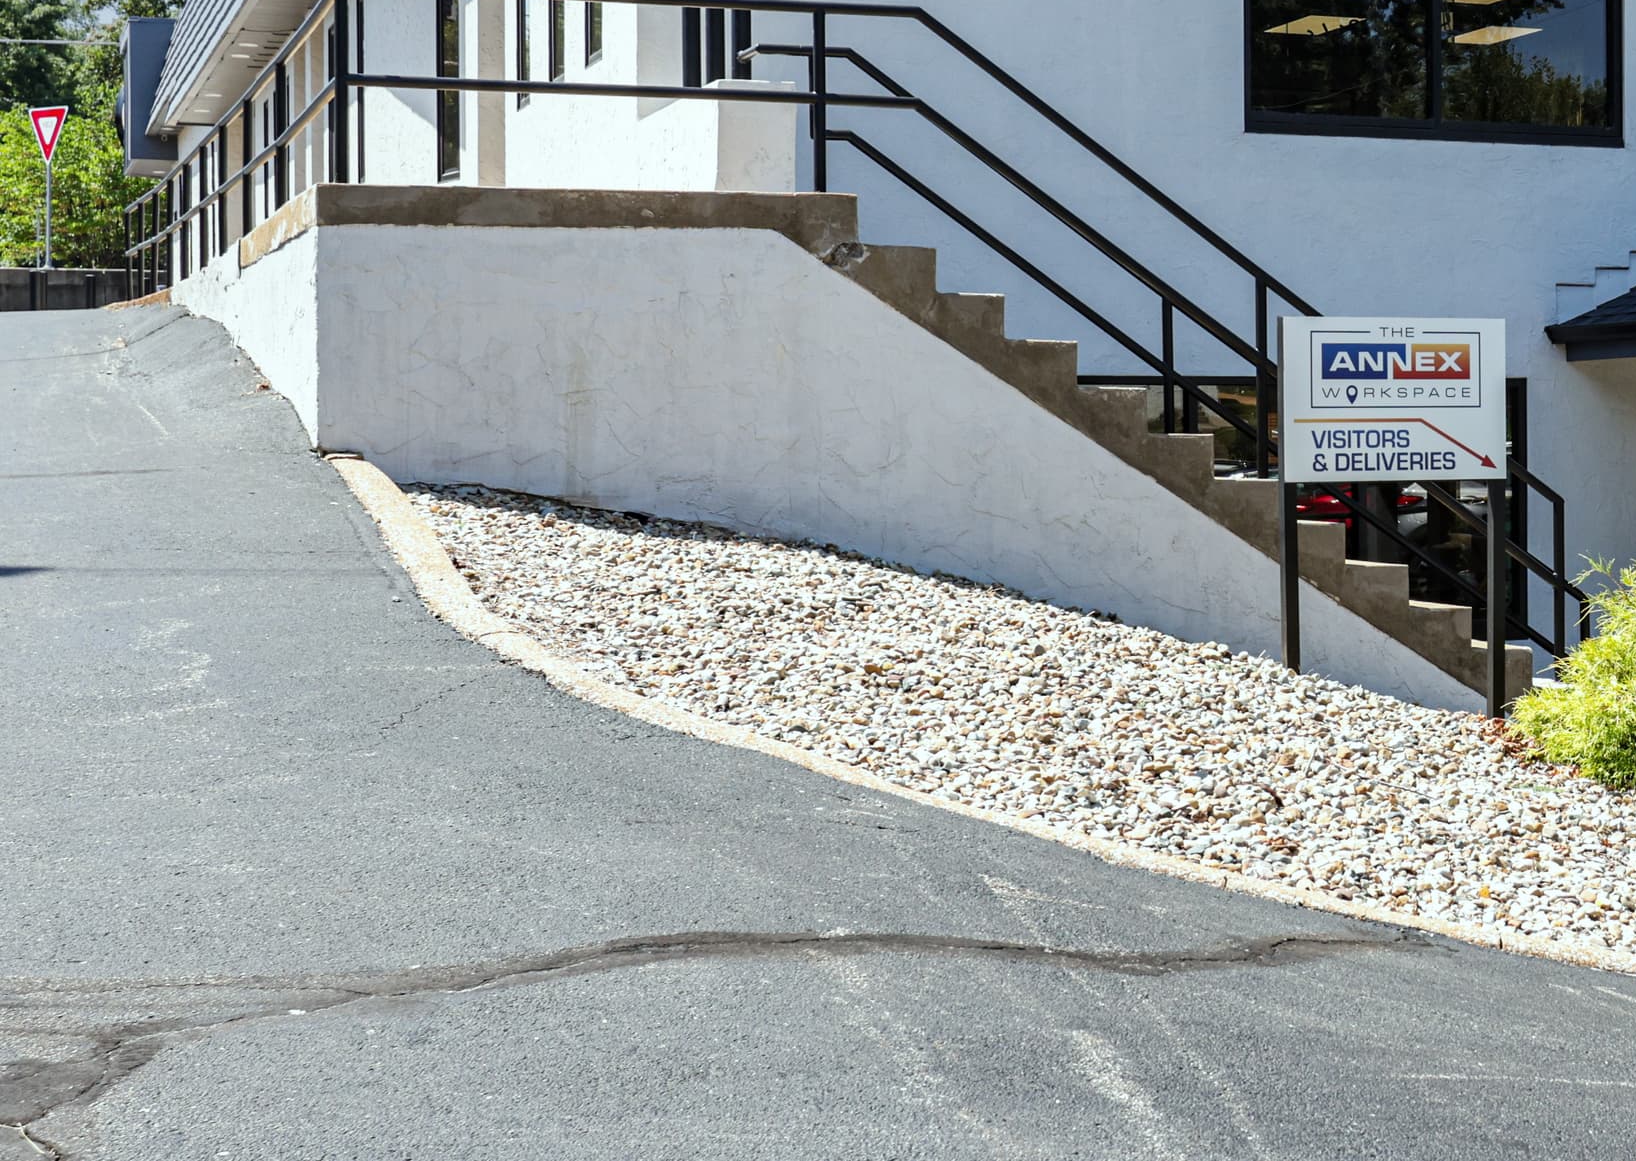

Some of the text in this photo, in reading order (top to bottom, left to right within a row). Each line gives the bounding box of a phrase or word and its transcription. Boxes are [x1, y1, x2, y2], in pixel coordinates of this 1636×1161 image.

[1378, 326, 1415, 338] THE
[1329, 346, 1463, 378] ANNEX
[1321, 385, 1471, 404] WORKSPACE
[1311, 429, 1410, 449] VISITORS
[1312, 451, 1456, 472] & DELIVERIES
